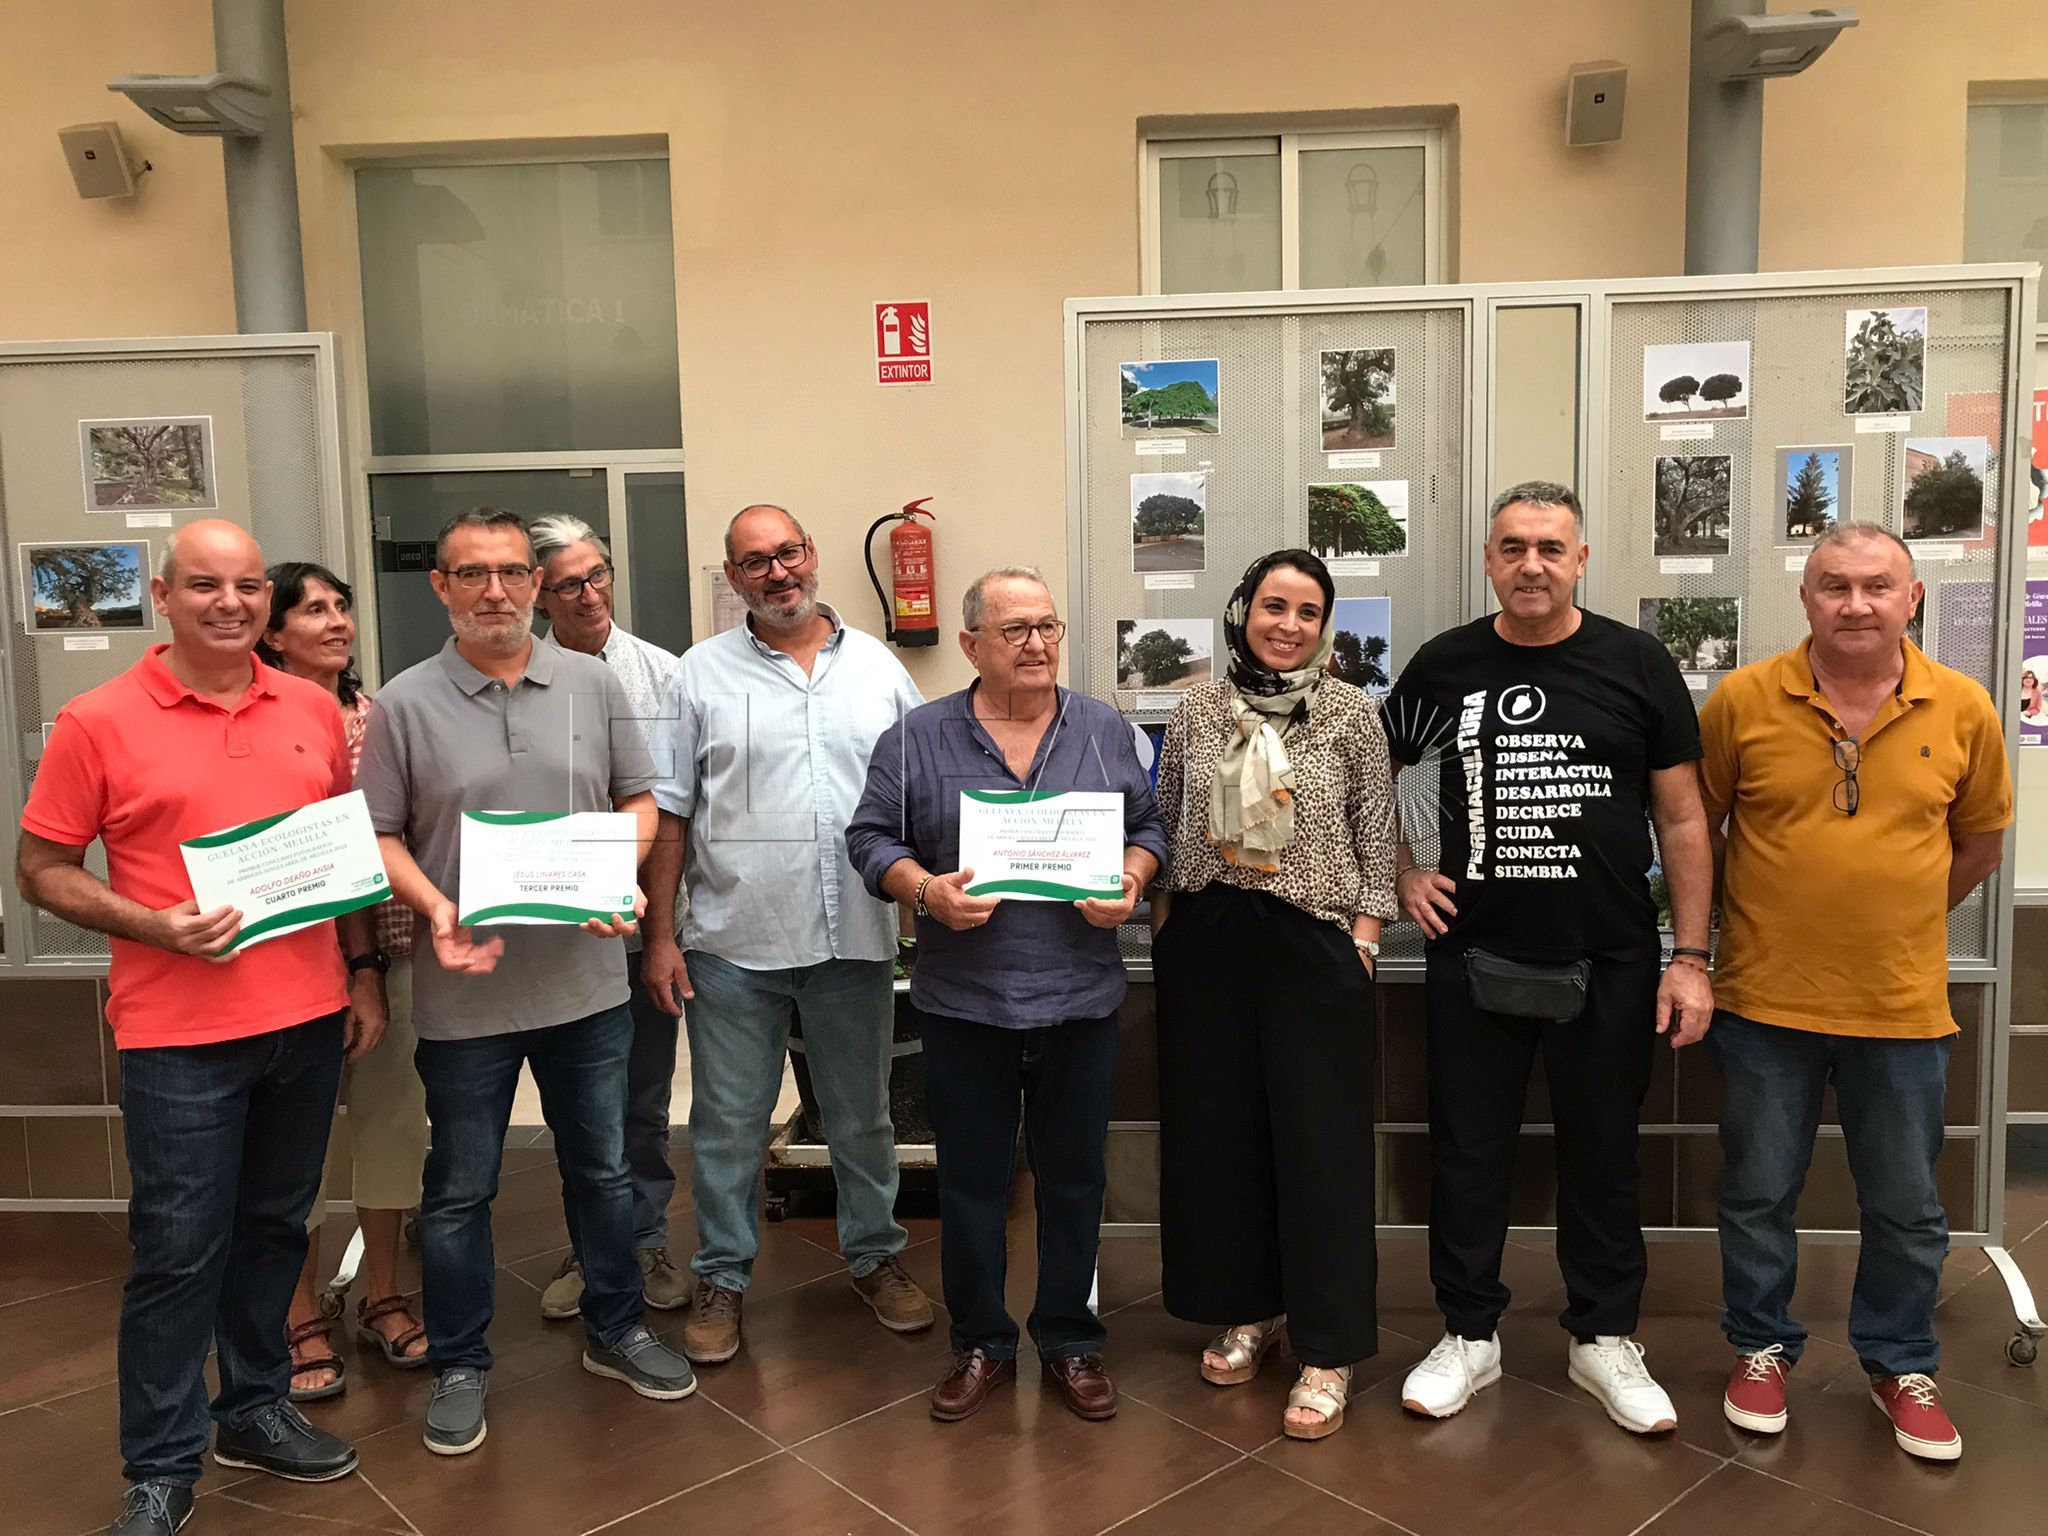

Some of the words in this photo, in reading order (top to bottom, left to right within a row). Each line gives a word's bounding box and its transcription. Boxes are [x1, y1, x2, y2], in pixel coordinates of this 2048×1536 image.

[881, 364, 928, 378] EXTINTOR
[2033, 401, 2048, 422] T
[1495, 735, 1585, 749] OBSERVA
[1495, 766, 1612, 781] INTERACTUA
[1457, 690, 1488, 880] PERMACULTURA
[1495, 784, 1612, 800] DESARROLLA
[1496, 803, 1581, 819] DECRECE
[208, 842, 259, 862] GUELAYA
[261, 819, 332, 846] ECOLOGISTAS
[336, 813, 350, 823] EN
[283, 831, 328, 849] MELILLA
[1496, 826, 1555, 840] CUIDA
[1028, 849, 1060, 858] SÁNCHEZ
[1062, 850, 1091, 858] ÁLVAREZ
[1496, 845, 1581, 860] CONECTA
[1042, 863, 1071, 871] PREMIO
[1495, 865, 1578, 879] SIEMBRA
[250, 880, 282, 895] ADOLFO
[284, 870, 311, 885] DEAÑO
[312, 864, 335, 875] ANSIA
[266, 890, 296, 905] CUARTO
[298, 880, 326, 894] PREMIO
